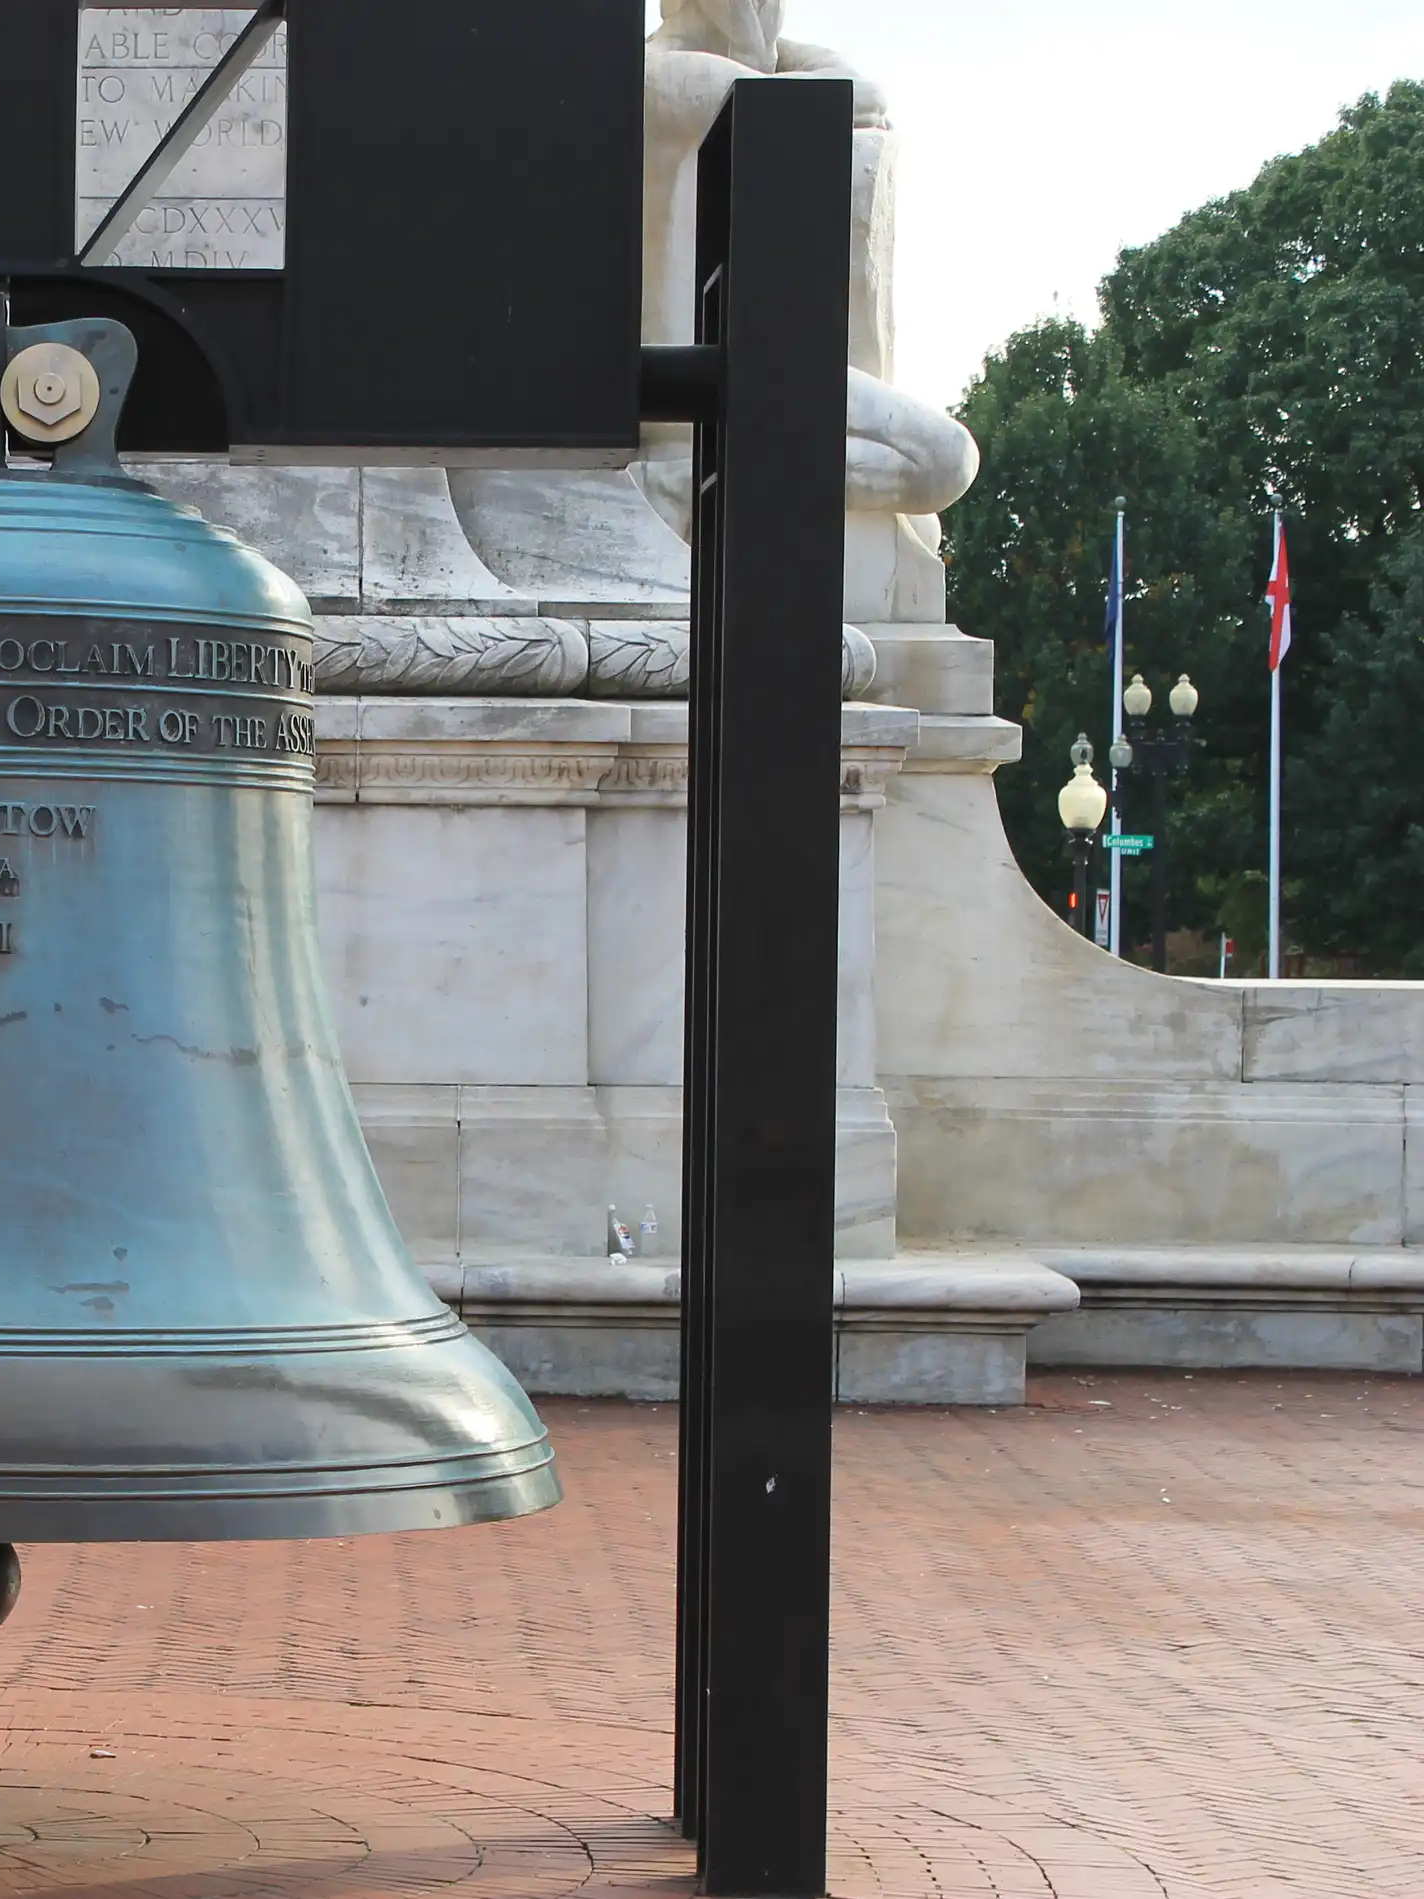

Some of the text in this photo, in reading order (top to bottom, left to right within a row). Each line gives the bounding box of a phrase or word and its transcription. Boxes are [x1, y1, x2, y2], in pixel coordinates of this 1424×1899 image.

[84, 32, 170, 60] ABLE
[80, 75, 125, 104] TO
[167, 636, 298, 689] LIBERTY
[6, 695, 150, 741] ORDER
[159, 708, 200, 744] OF
[212, 715, 267, 749] THE
[1107, 835, 1144, 847] Columbus
